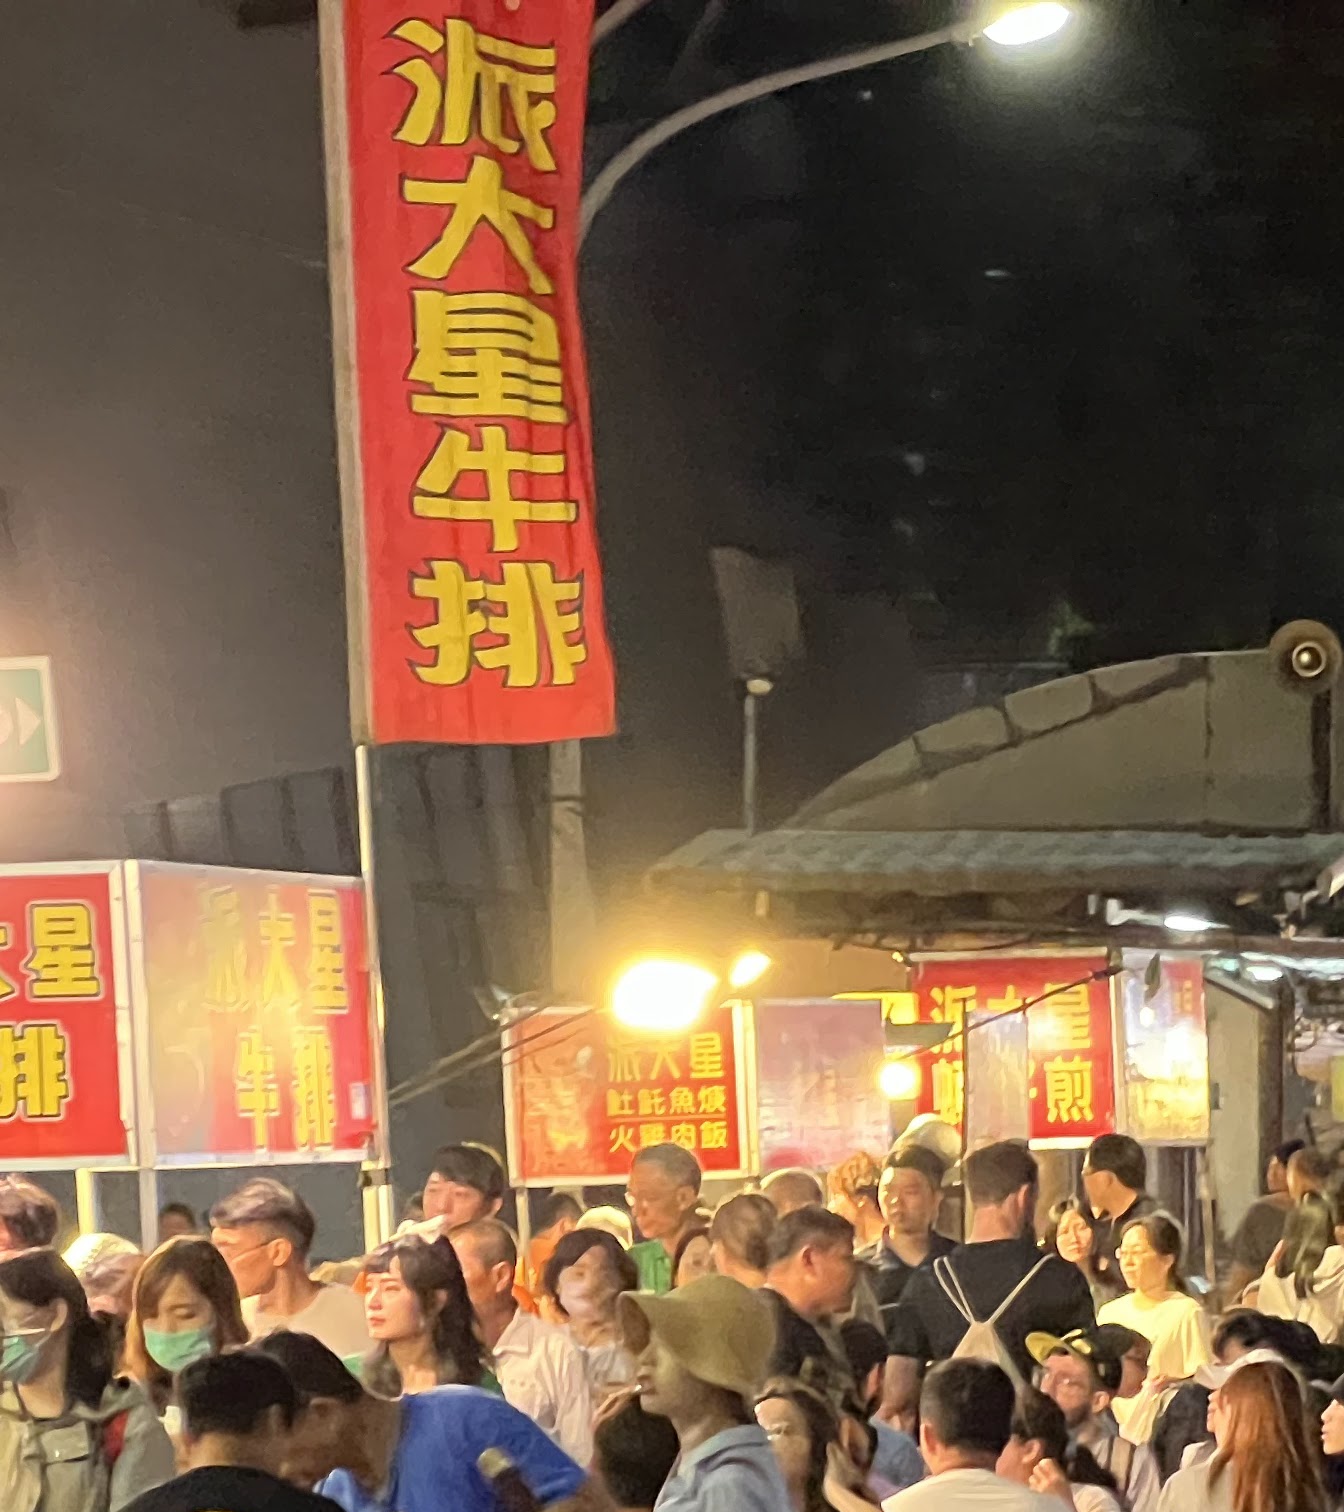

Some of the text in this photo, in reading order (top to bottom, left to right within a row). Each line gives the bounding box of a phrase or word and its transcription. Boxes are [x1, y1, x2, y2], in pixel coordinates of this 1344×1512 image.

[382, 17, 587, 687] 派大星牛排
